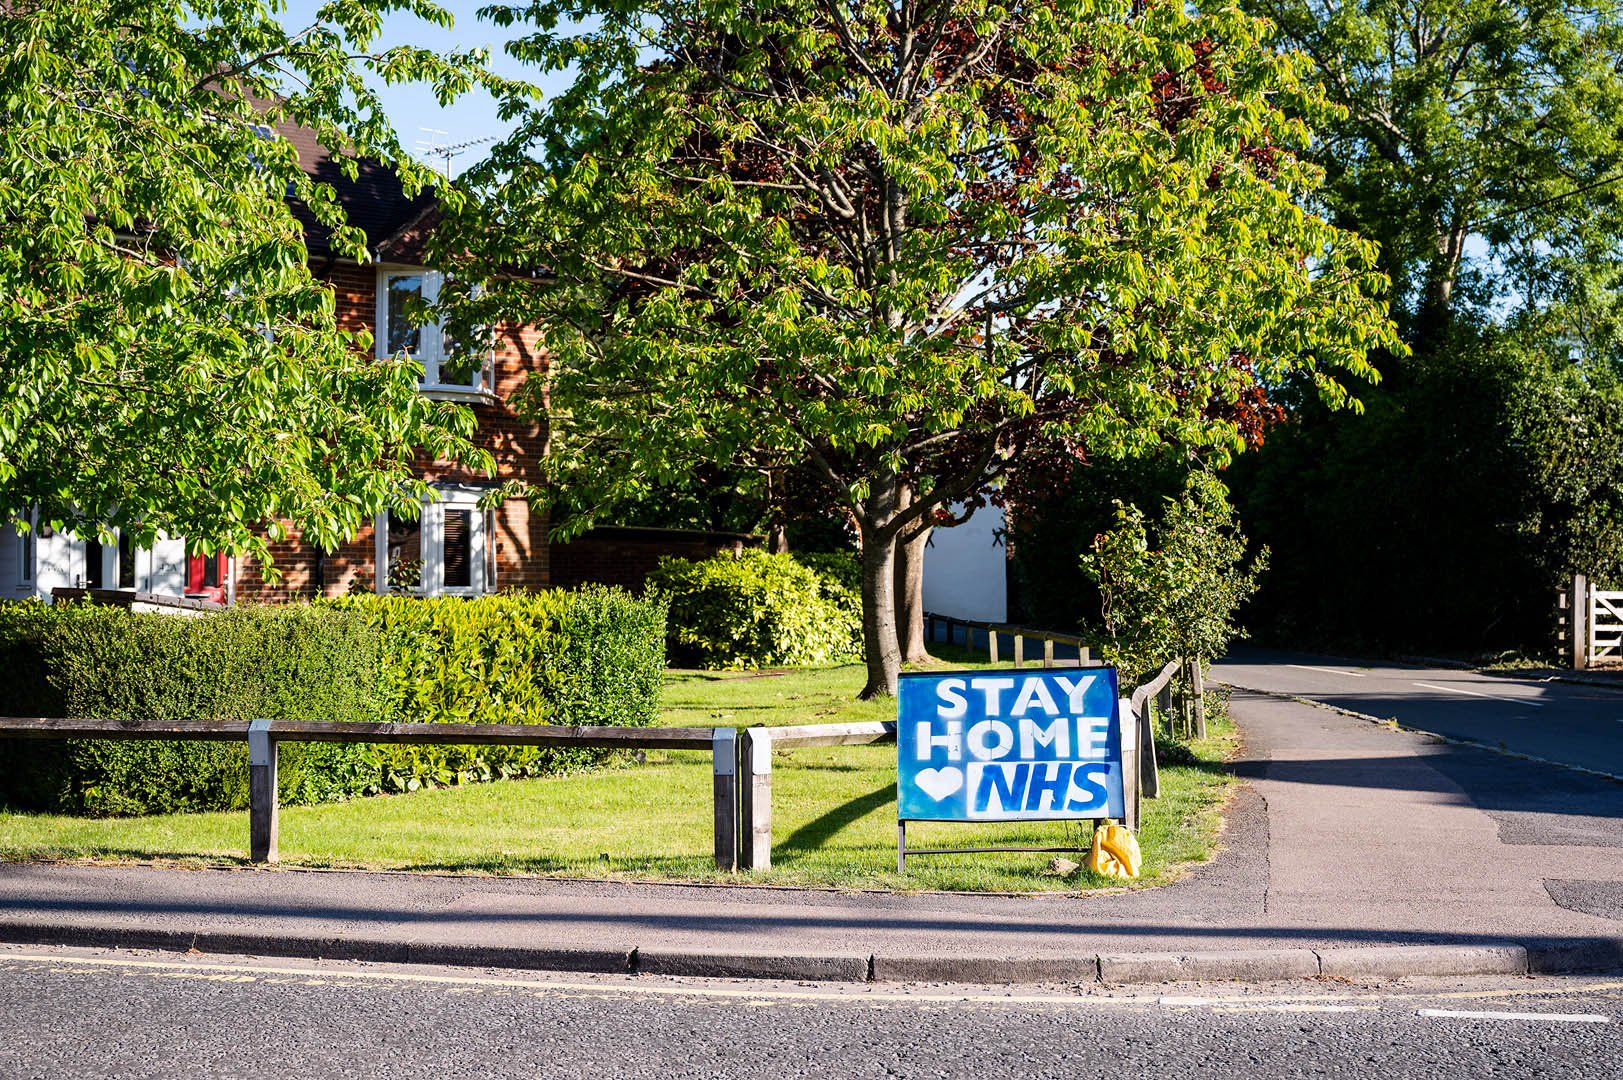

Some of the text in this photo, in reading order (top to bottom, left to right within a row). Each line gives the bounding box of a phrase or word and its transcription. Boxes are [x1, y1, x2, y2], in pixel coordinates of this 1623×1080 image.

[936, 675, 1097, 717] STAY
[916, 717, 1110, 761] HOME
[975, 763, 1110, 812] NHS
